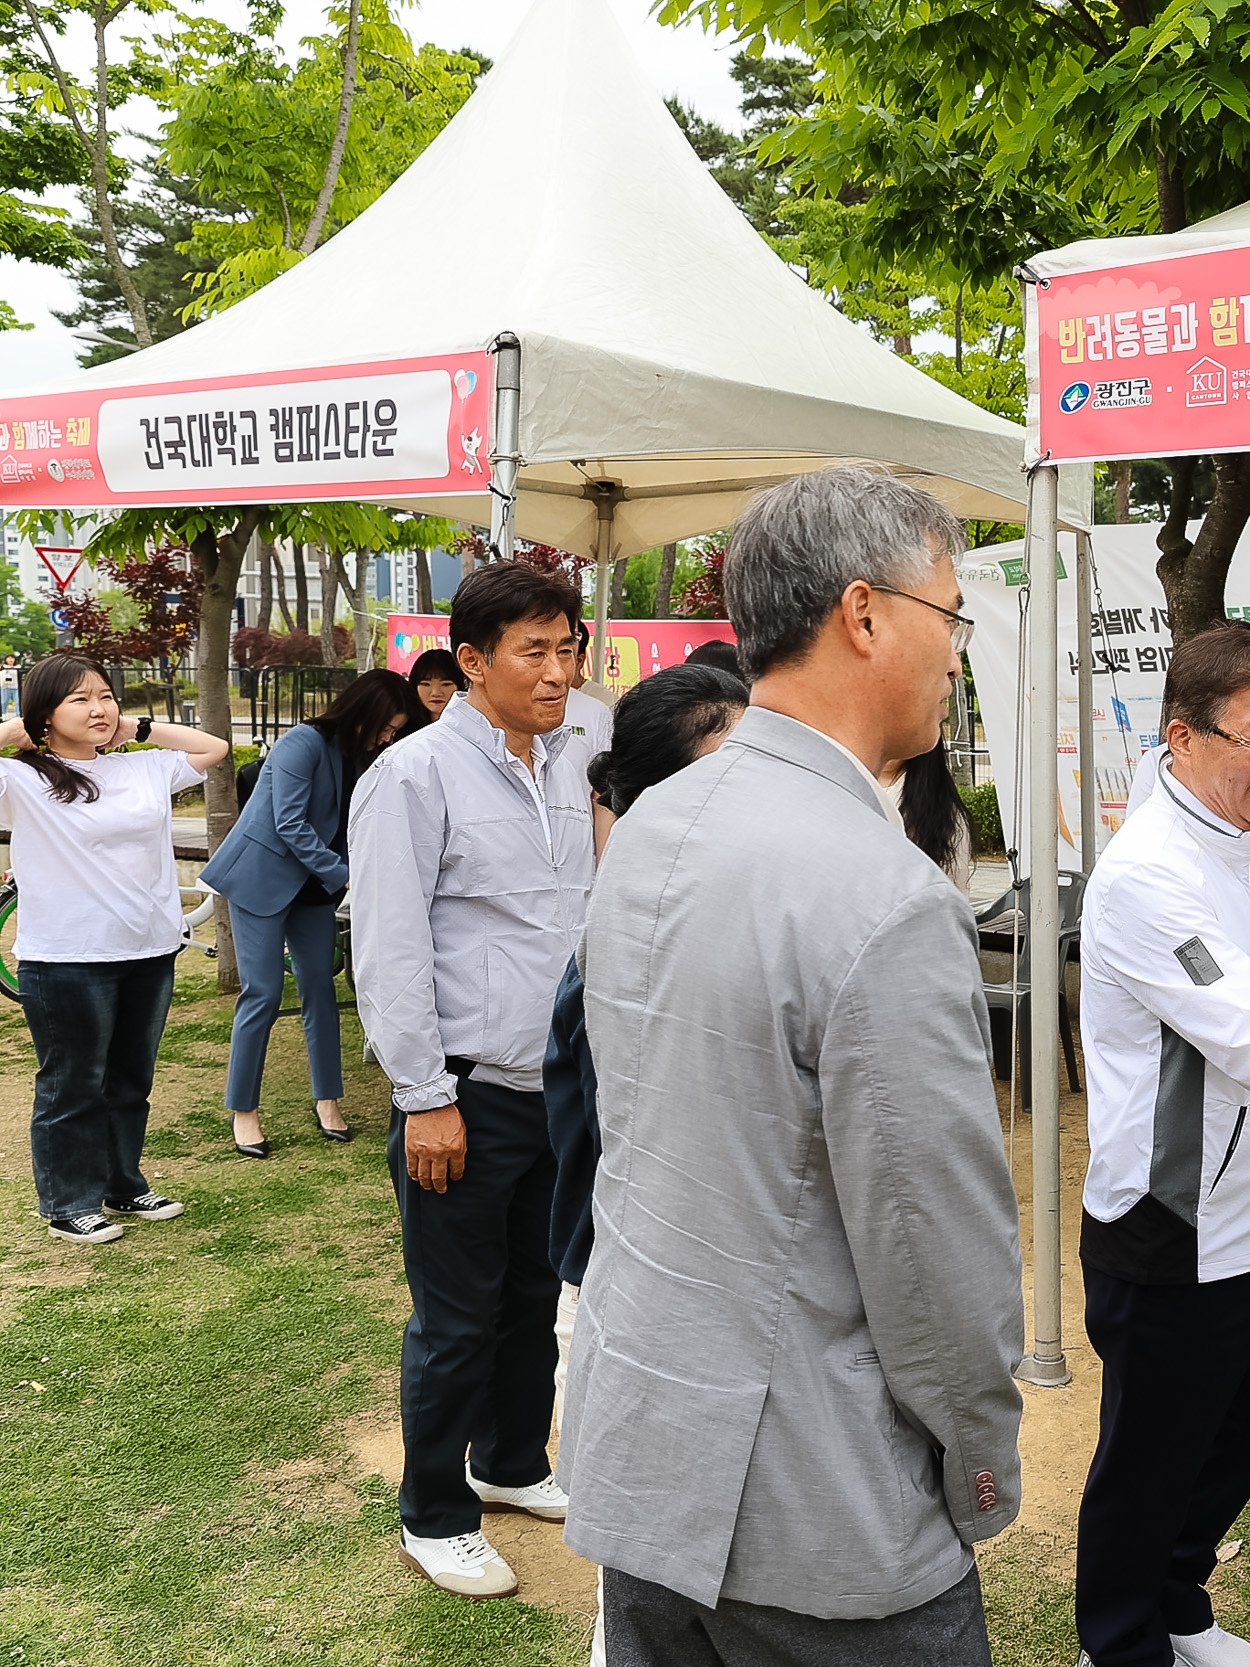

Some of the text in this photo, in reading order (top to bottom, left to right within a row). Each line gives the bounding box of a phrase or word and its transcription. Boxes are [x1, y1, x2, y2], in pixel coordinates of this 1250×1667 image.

[1058, 302, 1199, 364] 반려동물과
[1095, 379, 1150, 399] 광진구
[1191, 371, 1223, 392] KU
[12, 419, 63, 451] 함께하는
[66, 417, 91, 447] 축제
[140, 399, 398, 470] 건국대학교 캠퍼스타운
